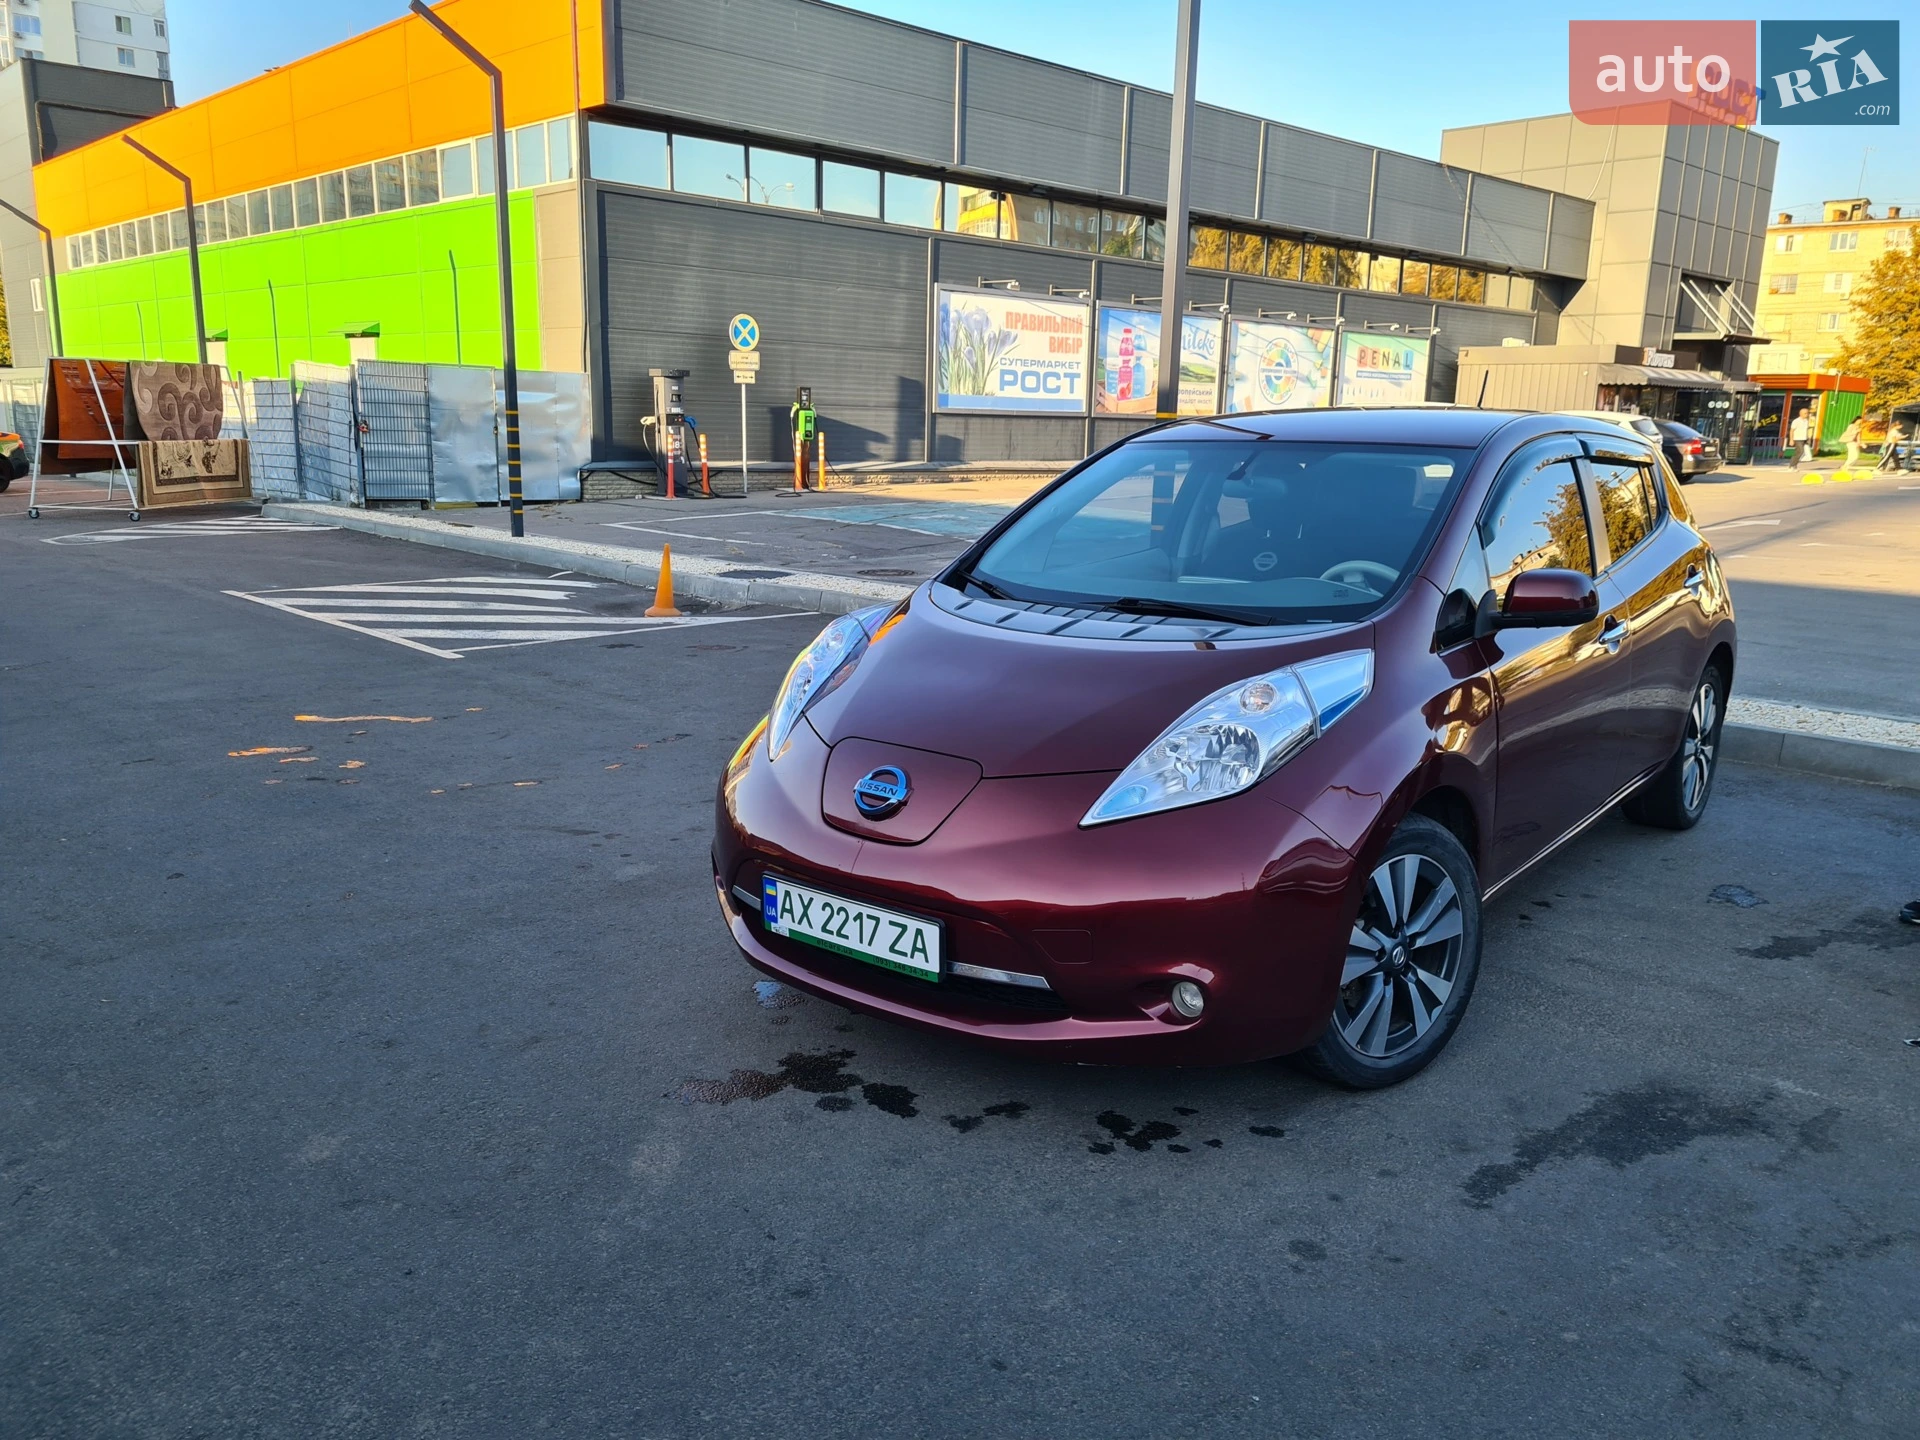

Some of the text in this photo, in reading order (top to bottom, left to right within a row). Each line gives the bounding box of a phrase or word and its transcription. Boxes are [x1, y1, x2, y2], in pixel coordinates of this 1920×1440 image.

[1005, 311, 1083, 335] ПРАВИЛЬНИЙ
[1049, 336, 1083, 354] ВИБІР
[1000, 357, 1081, 370] СУПЕРМАРКЕТ
[1359, 349, 1411, 368] PENAL
[1000, 369, 1081, 394] РОСТ
[858, 781, 898, 796] NISSAN
[766, 905, 777, 917] UA
[779, 889, 929, 964] AX 2217 ZA
